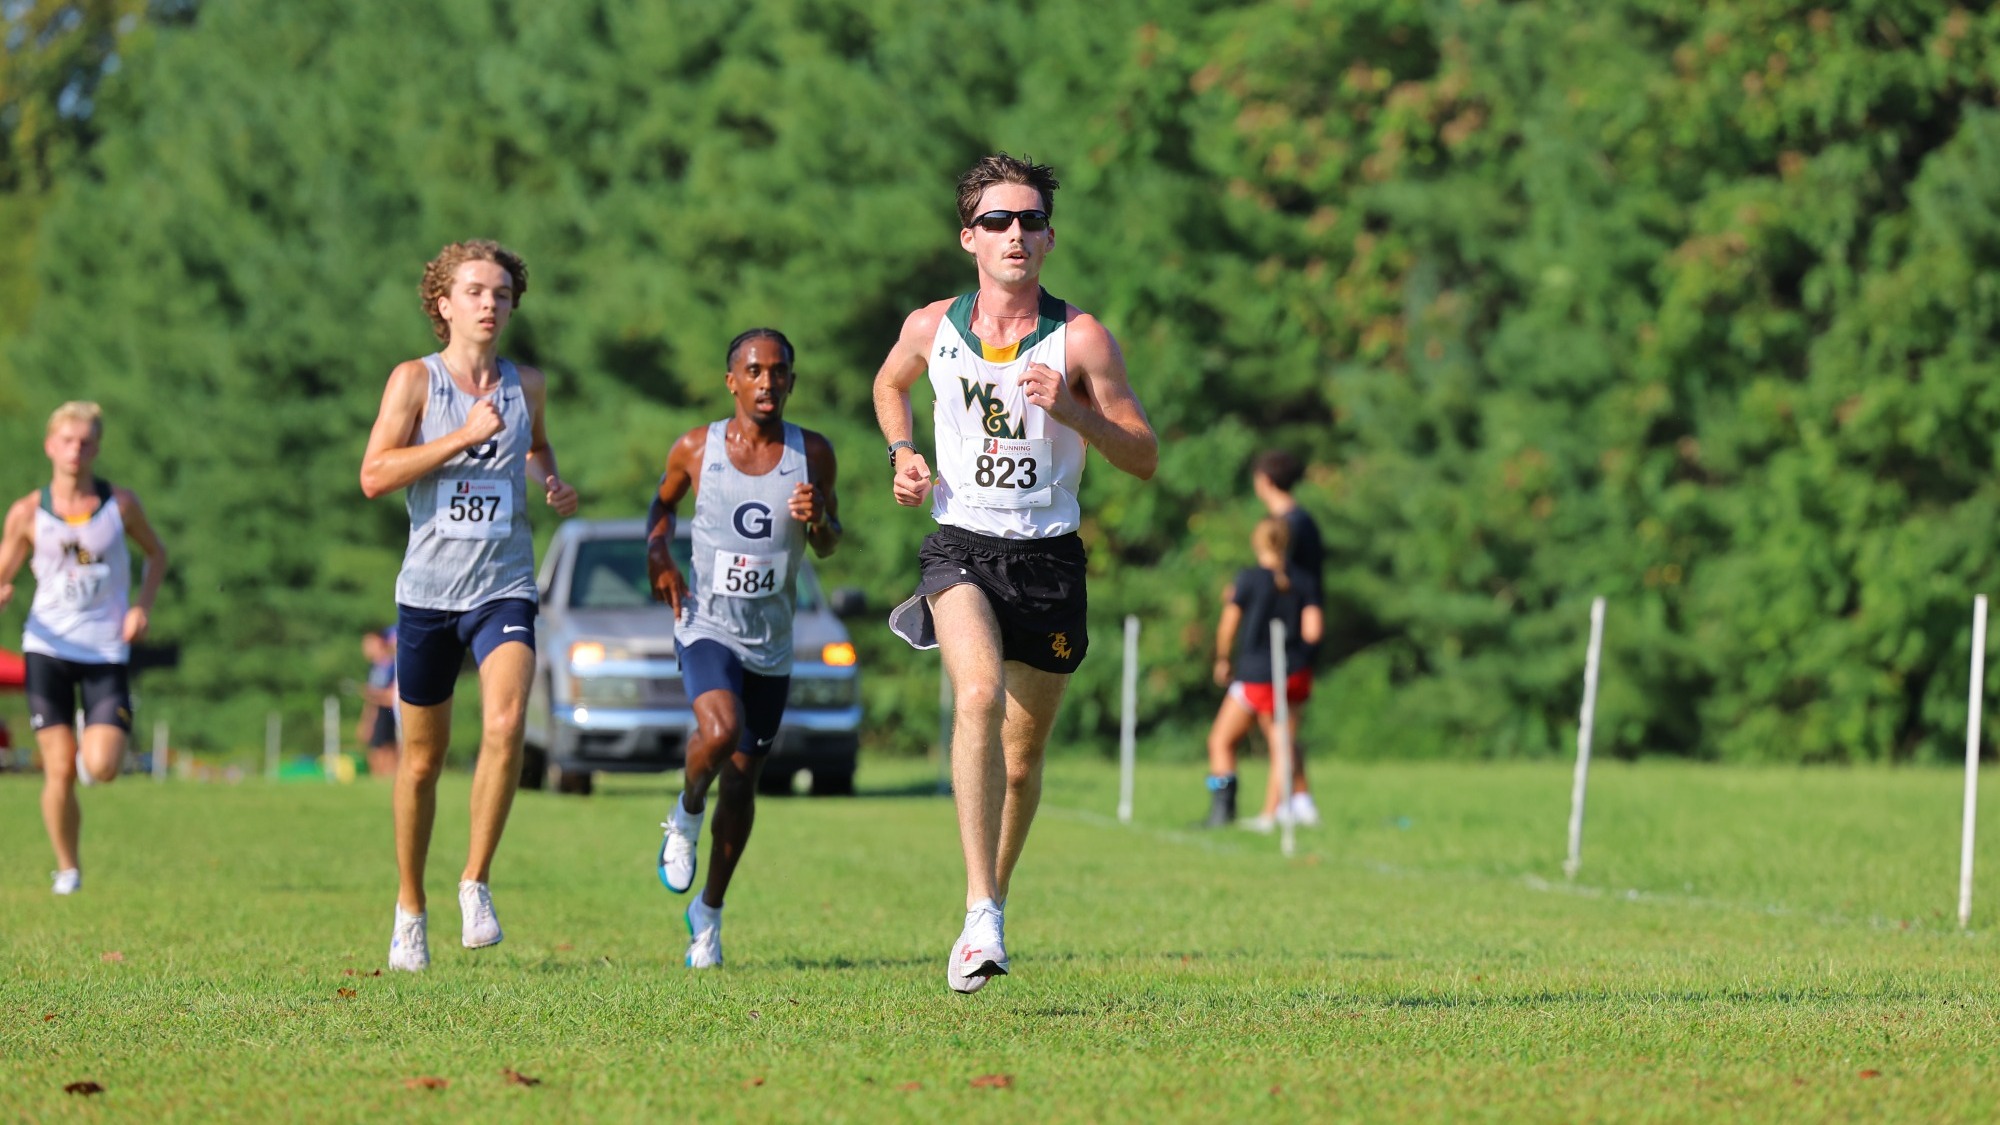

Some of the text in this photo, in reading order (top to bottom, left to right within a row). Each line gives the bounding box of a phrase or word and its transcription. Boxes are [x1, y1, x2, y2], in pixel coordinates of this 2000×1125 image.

[999, 444, 1031, 452] RUNNING
[975, 455, 1037, 489] 823
[450, 496, 501, 522] 587
[733, 502, 774, 540] G
[726, 568, 775, 594] 584
